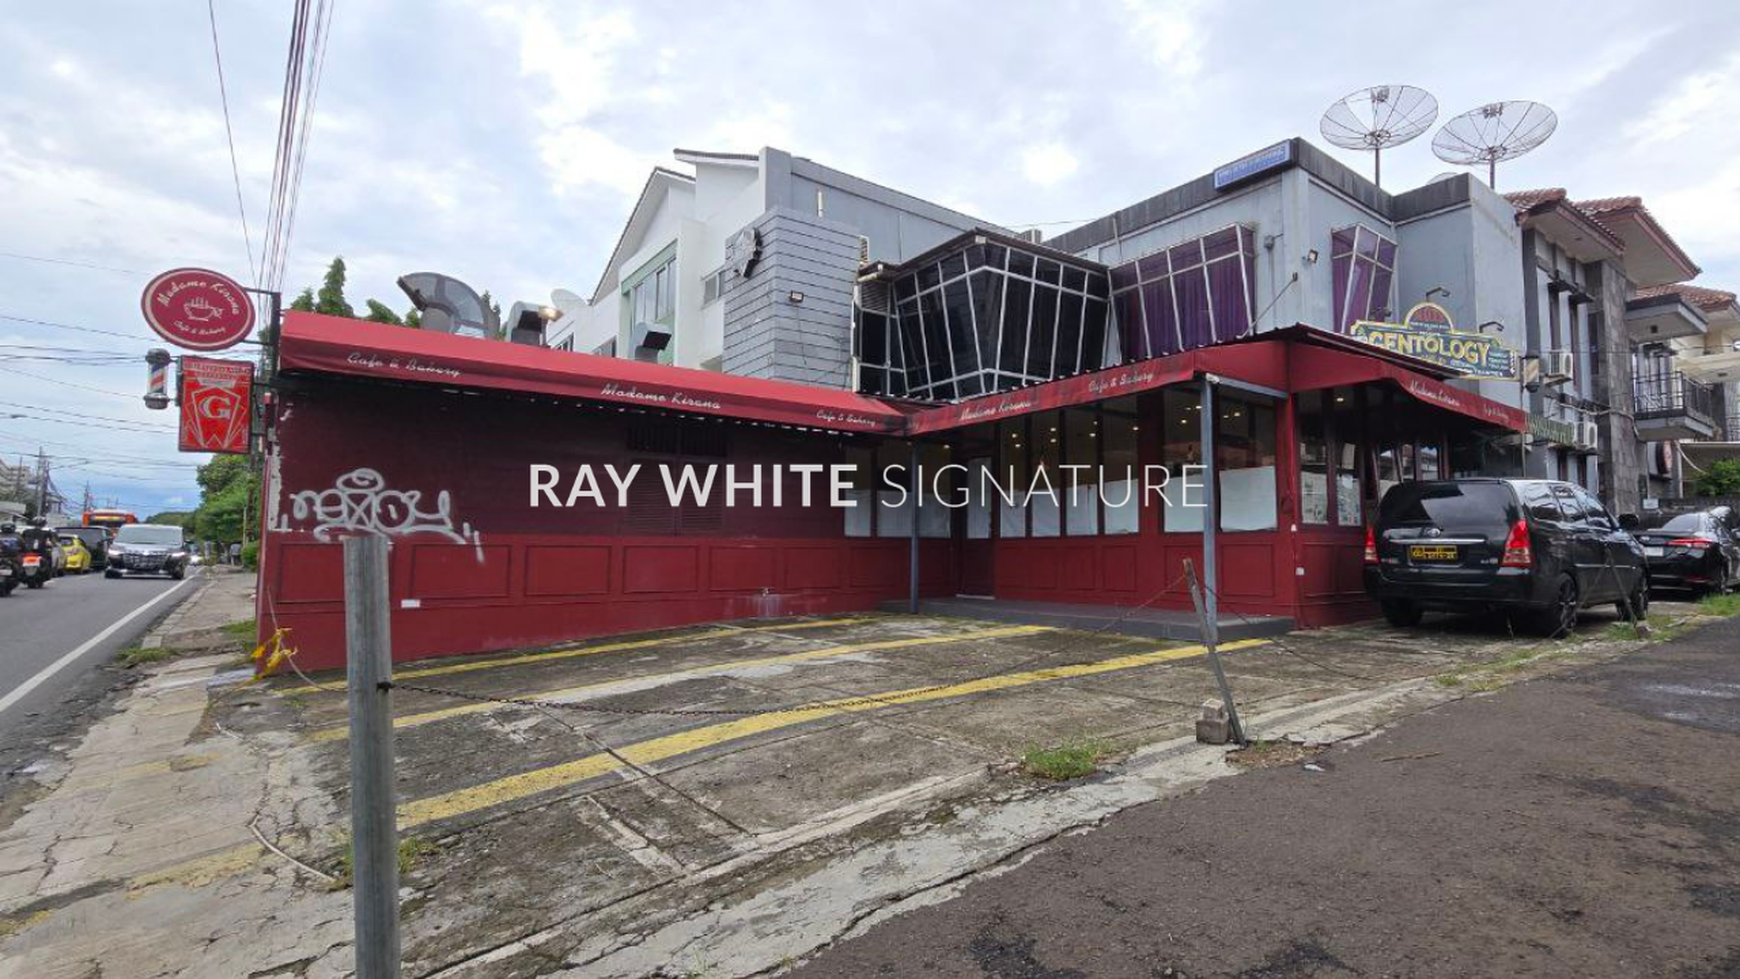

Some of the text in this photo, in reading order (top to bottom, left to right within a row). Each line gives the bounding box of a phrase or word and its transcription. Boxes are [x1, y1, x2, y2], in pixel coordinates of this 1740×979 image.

[157, 281, 207, 307] Madame
[198, 395, 232, 420] G
[600, 382, 722, 410] Madame Kirana
